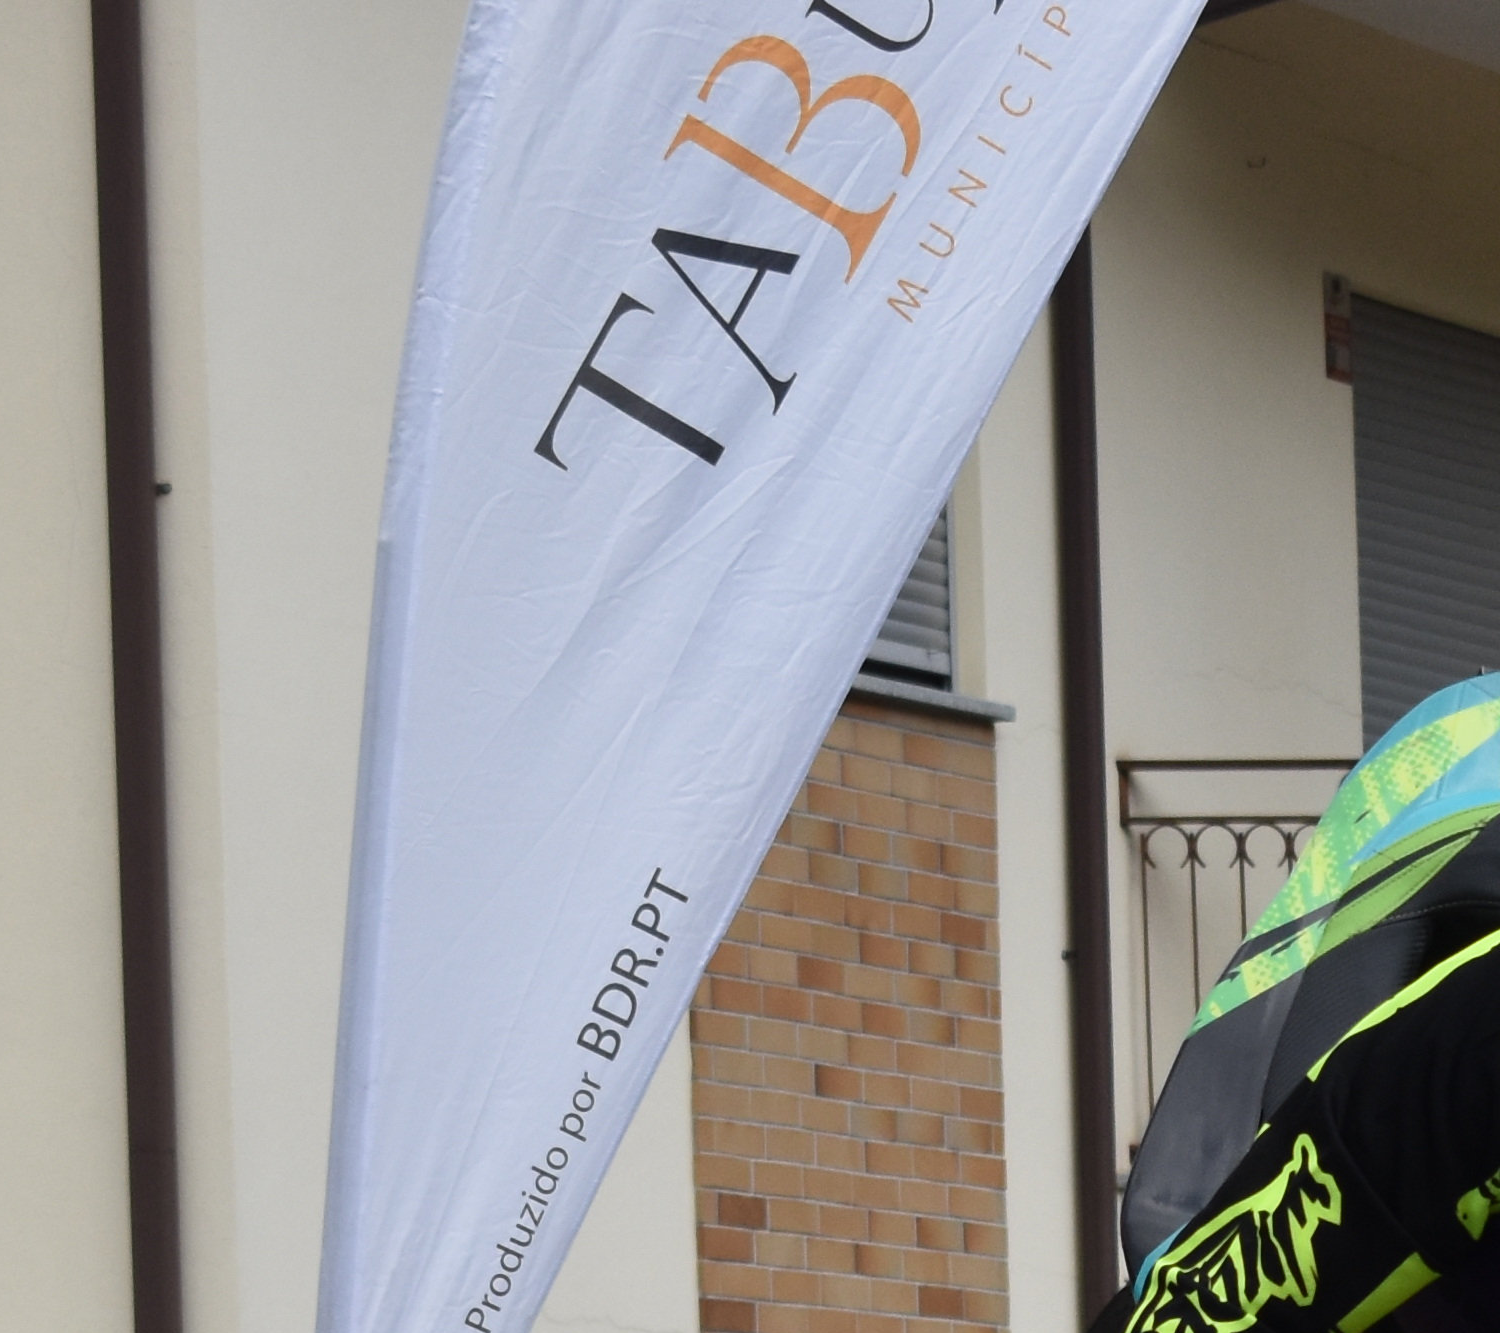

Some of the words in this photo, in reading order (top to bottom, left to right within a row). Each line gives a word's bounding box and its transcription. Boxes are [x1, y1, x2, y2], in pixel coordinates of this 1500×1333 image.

[533, 0, 1000, 473] TABU
[886, 4, 1072, 323] MUNICÍP
[576, 867, 689, 1061] BDR.PT
[559, 1071, 602, 1142] por
